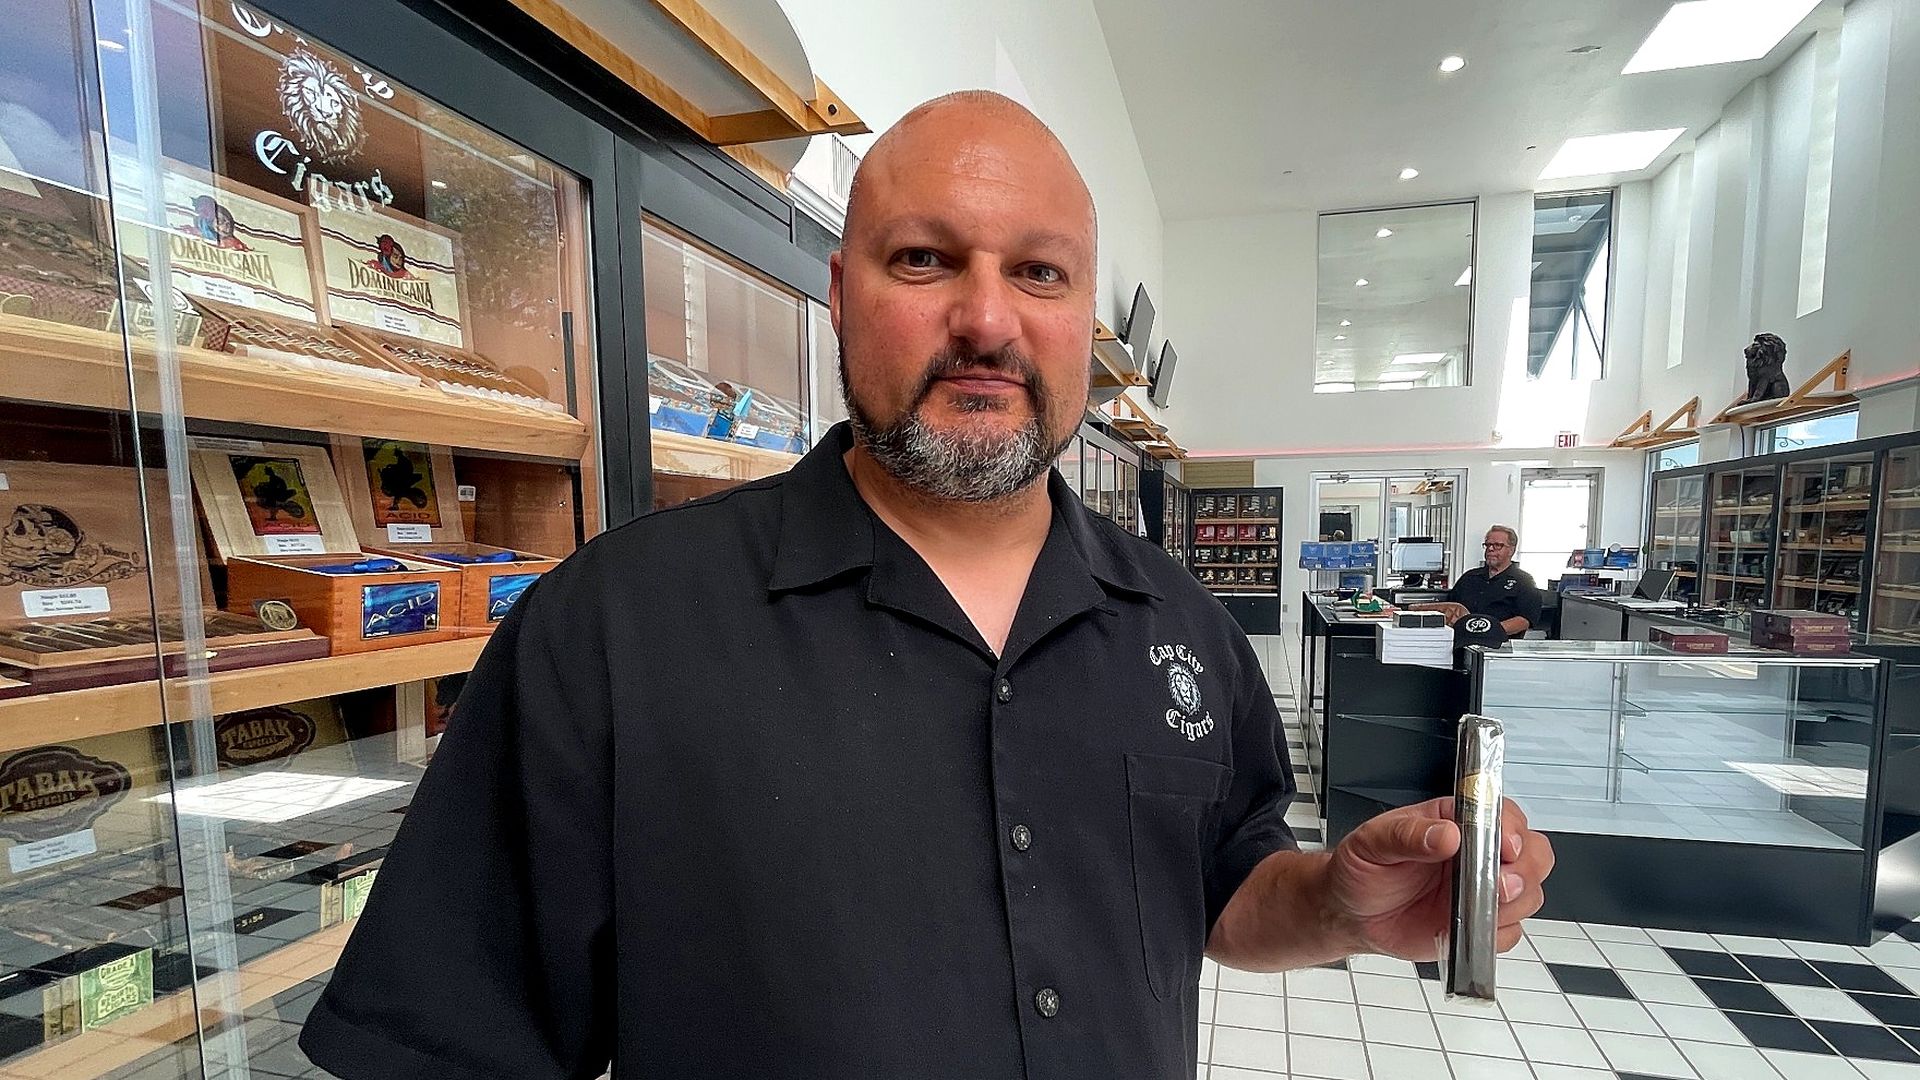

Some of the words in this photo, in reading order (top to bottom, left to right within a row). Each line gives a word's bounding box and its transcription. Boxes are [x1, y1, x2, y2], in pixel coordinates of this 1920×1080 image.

[255, 130, 394, 212] Cigars
[169, 235, 277, 289] OMINICANA
[347, 258, 434, 310] DOMINICANA
[1558, 434, 1578, 448] EXIT
[366, 591, 435, 629] ACID
[491, 588, 526, 614] AC
[1149, 644, 1175, 666] Cap
[1175, 644, 1205, 675] City
[221, 718, 295, 749] TABAK
[1165, 708, 1214, 742] Cigars
[0, 769, 99, 811] TABAK
